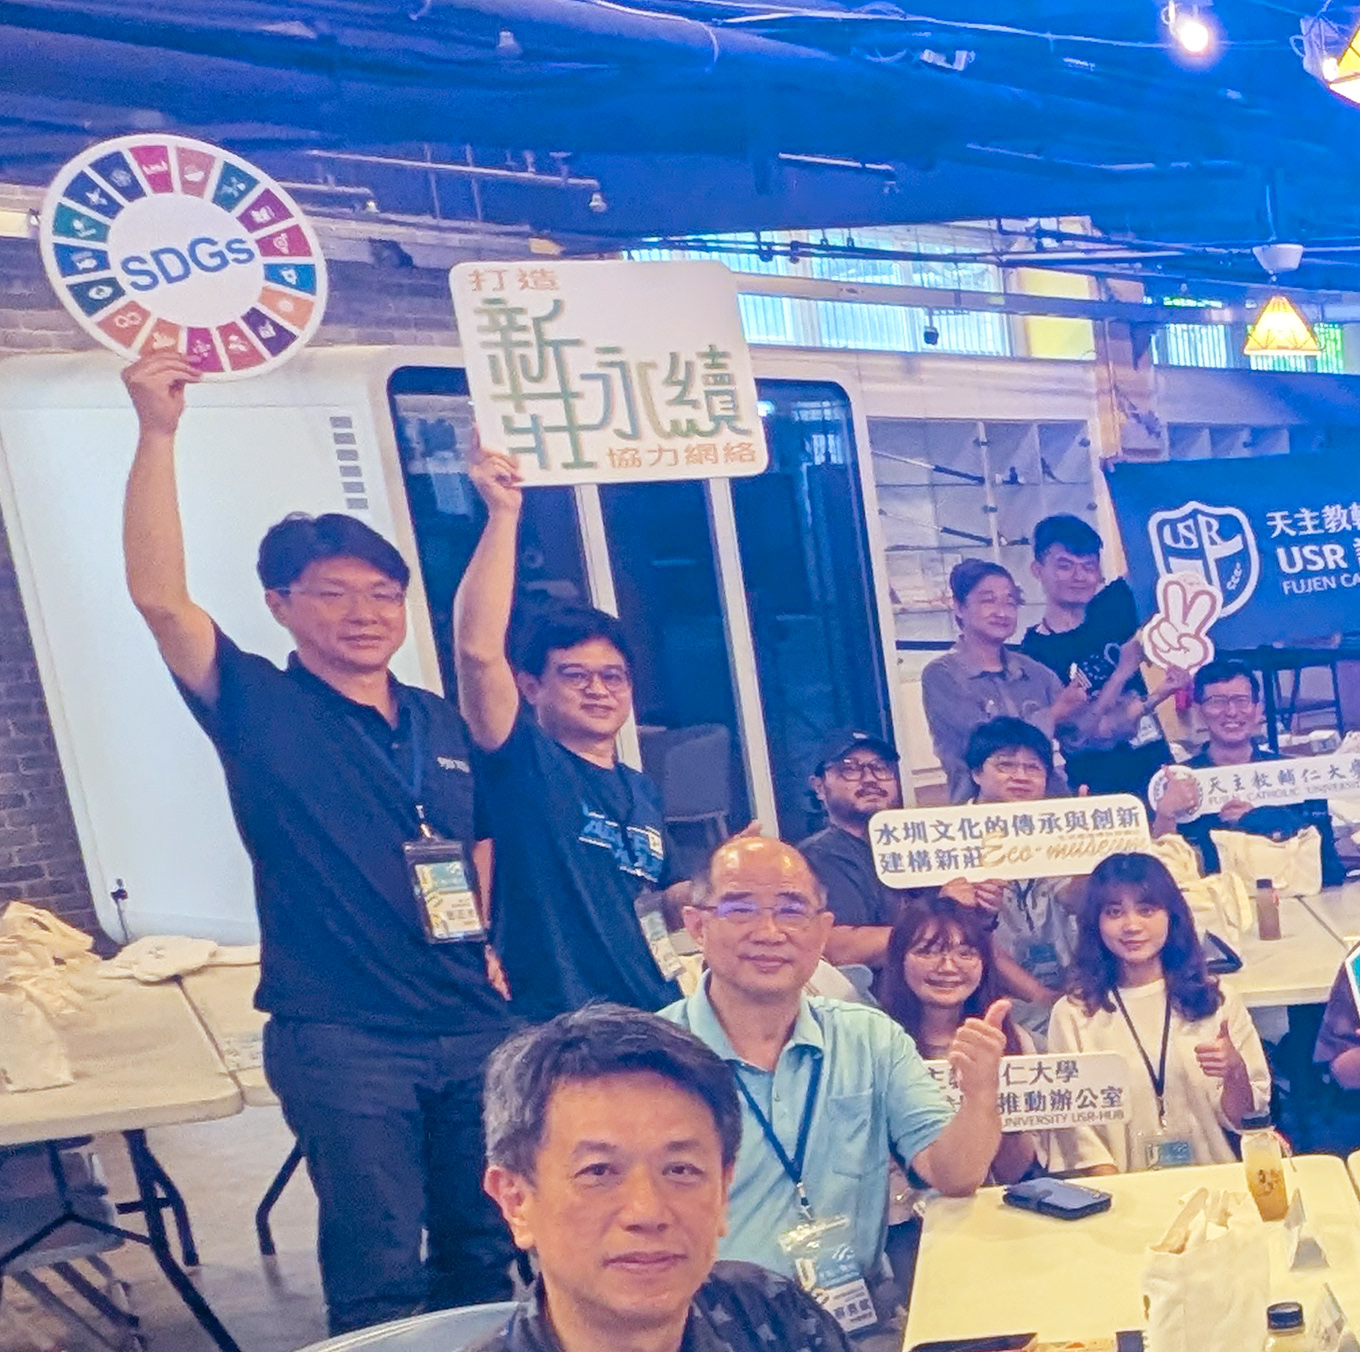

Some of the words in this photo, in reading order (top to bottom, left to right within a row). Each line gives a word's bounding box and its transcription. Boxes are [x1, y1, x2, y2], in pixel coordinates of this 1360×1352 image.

[121, 237, 255, 292] SDGs
[468, 267, 560, 293] 打造
[580, 344, 753, 441] 永續
[606, 442, 758, 469] 協力網絡
[1275, 543, 1348, 574] USR
[1282, 574, 1337, 595] FUJEN
[874, 806, 1140, 845] 水圳文化的傳承與創新
[880, 846, 984, 874] 建構新莊
